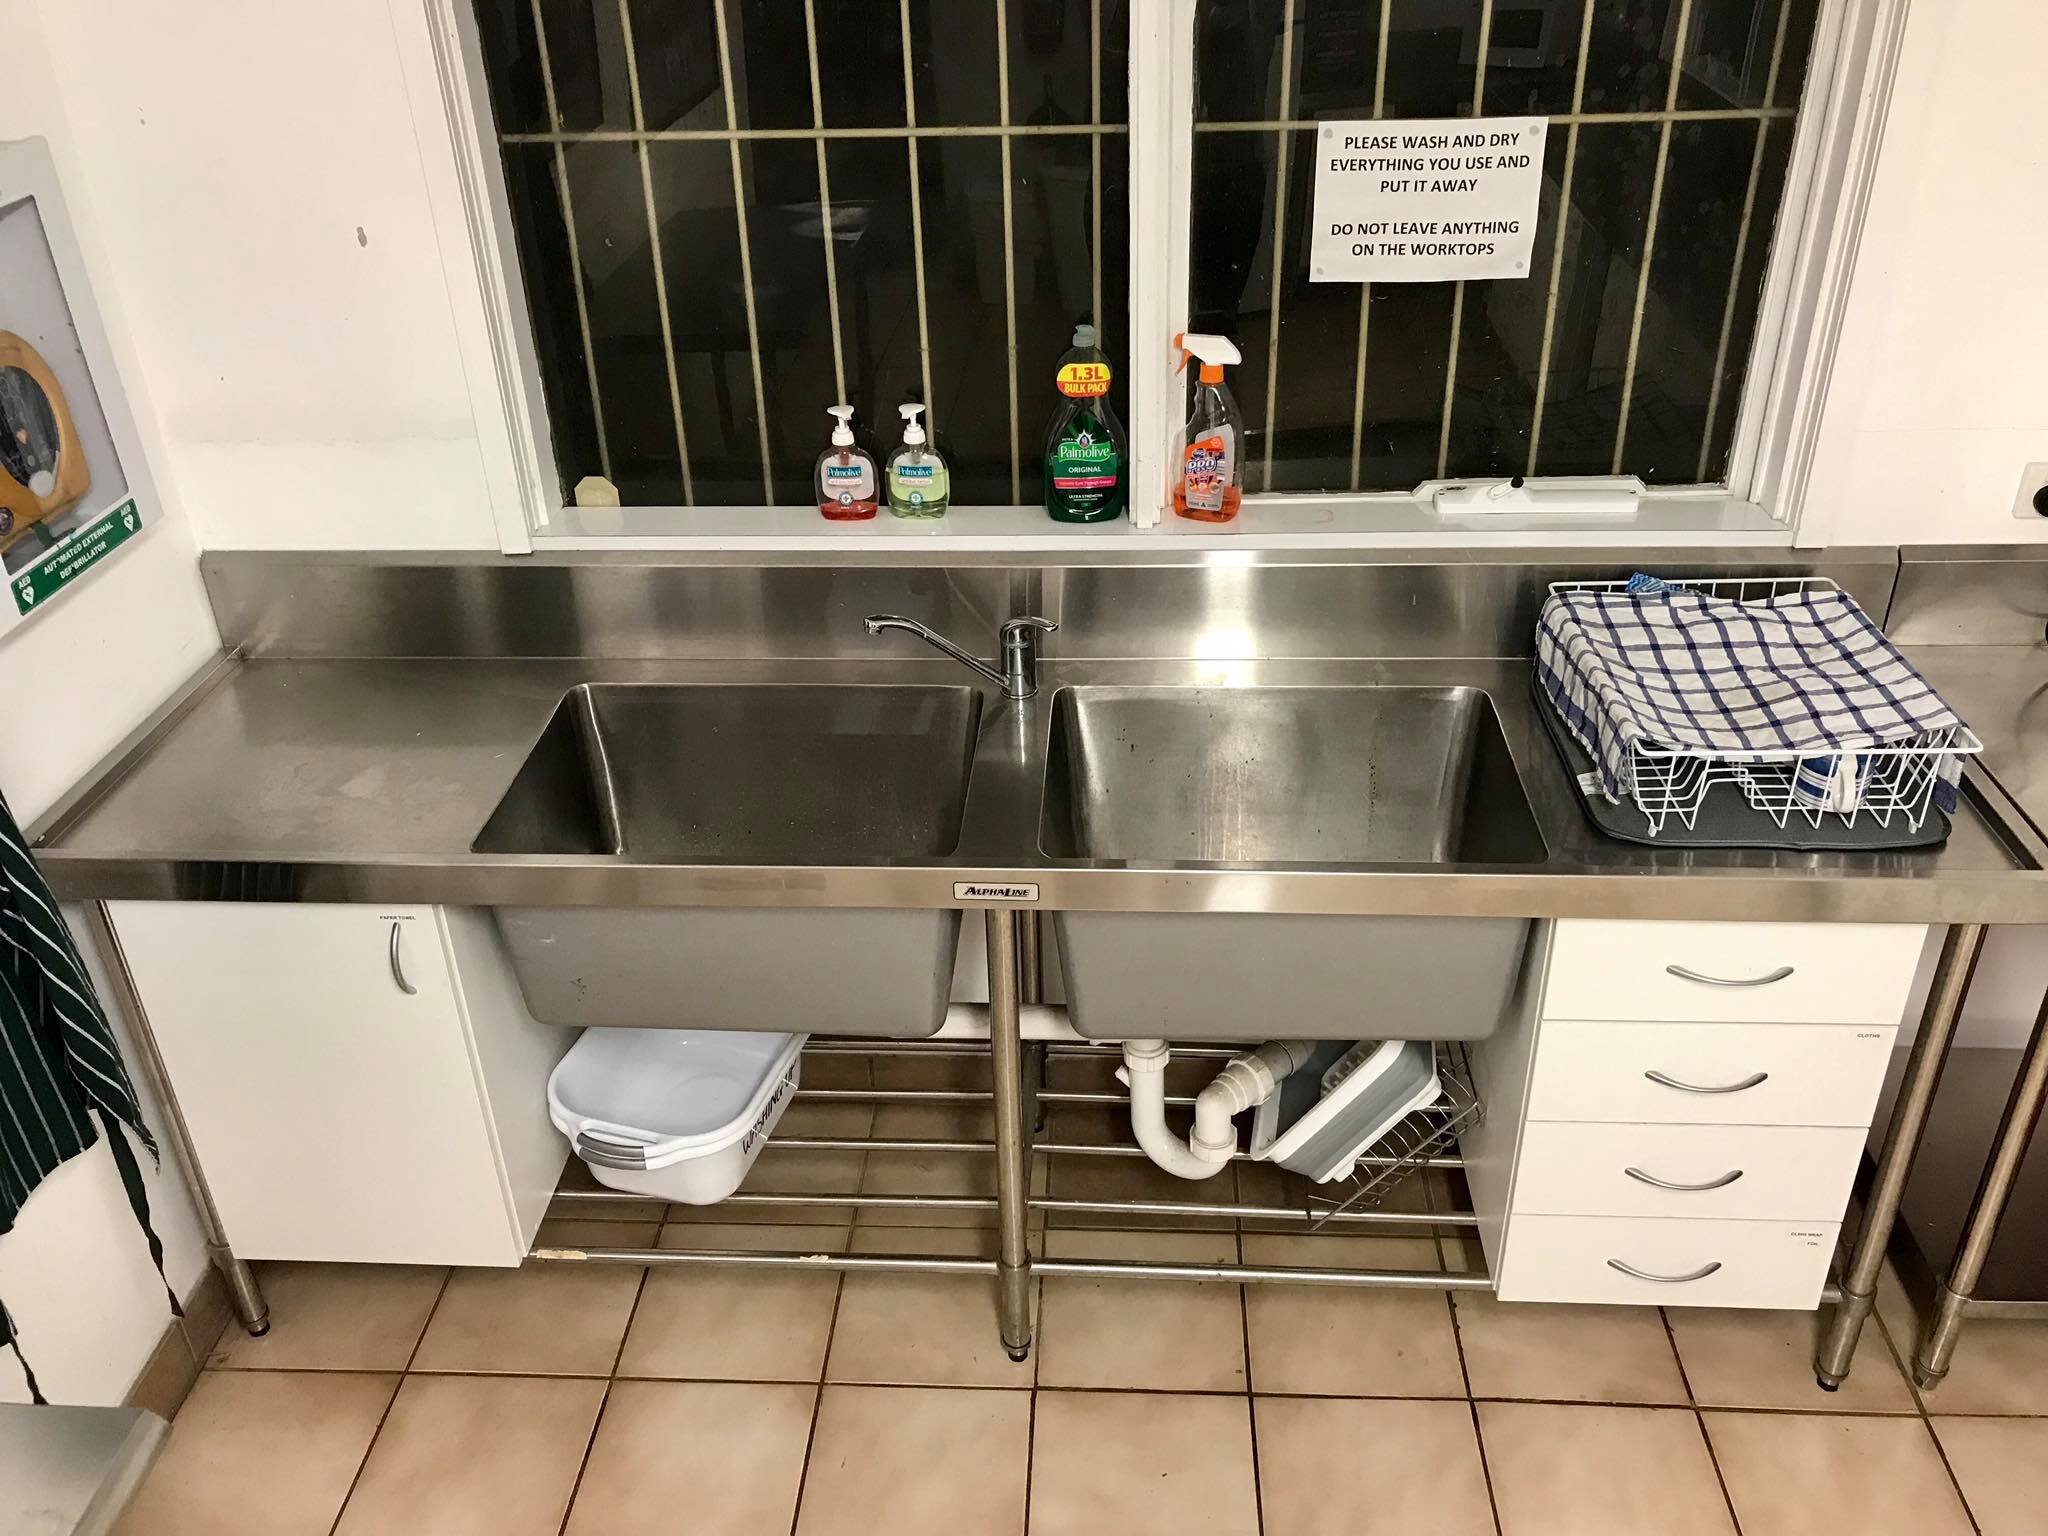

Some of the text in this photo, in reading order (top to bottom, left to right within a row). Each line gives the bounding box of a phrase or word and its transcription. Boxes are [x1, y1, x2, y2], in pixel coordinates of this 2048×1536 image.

[1344, 133, 1520, 150] PLEASE WASH AND DRY
[1330, 155, 1530, 172] EVERYTHING YOU USE AND
[1380, 179, 1478, 193] PUT IT AWAY
[1331, 221, 1520, 236] DO NOT LEAVE ANYTHING
[1351, 242, 1495, 256] ON THE WORKTOPS
[1070, 366, 1104, 381] 1.3L
[1064, 382, 1108, 393] BULK PACK
[1060, 445, 1110, 458] Palmolive
[828, 467, 861, 477] Palmolive
[898, 466, 932, 477] Palmolive
[44, 521, 114, 576] AUTMATED EXTERNAL
[18, 575, 31, 589] AED
[742, 1081, 784, 1155] WASHING
